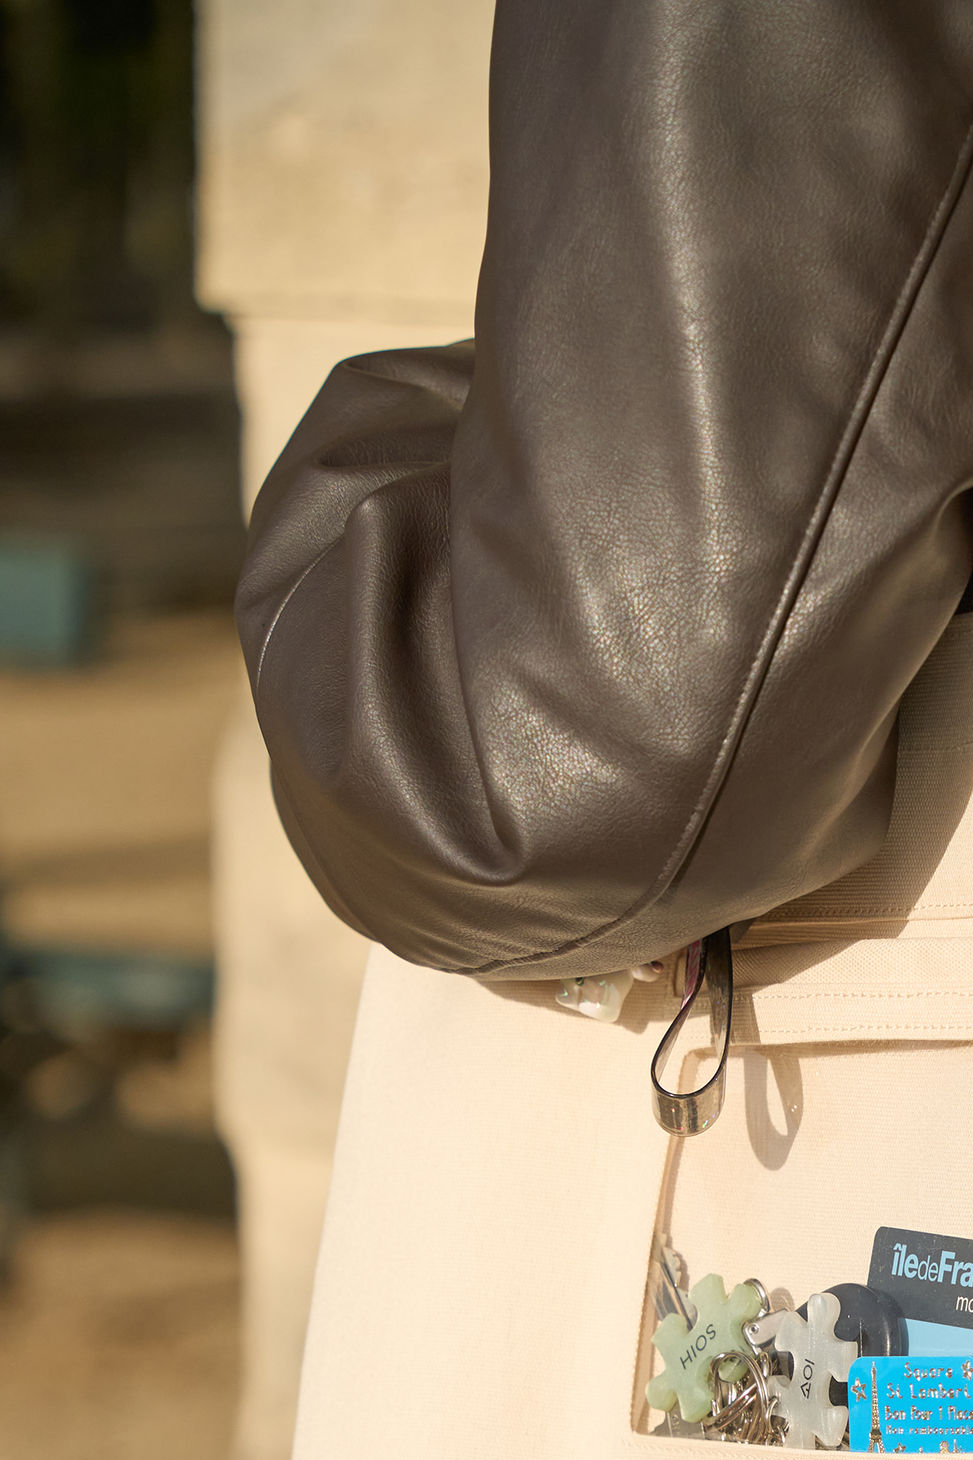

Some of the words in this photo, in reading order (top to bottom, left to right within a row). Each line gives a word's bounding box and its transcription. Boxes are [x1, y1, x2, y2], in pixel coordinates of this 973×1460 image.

[903, 1361, 953, 1382] Square
[886, 1382, 903, 1399] St
[909, 1383, 972, 1399] Lambert
[884, 1405, 906, 1421] Bon
[938, 1405, 943, 1420] 1
